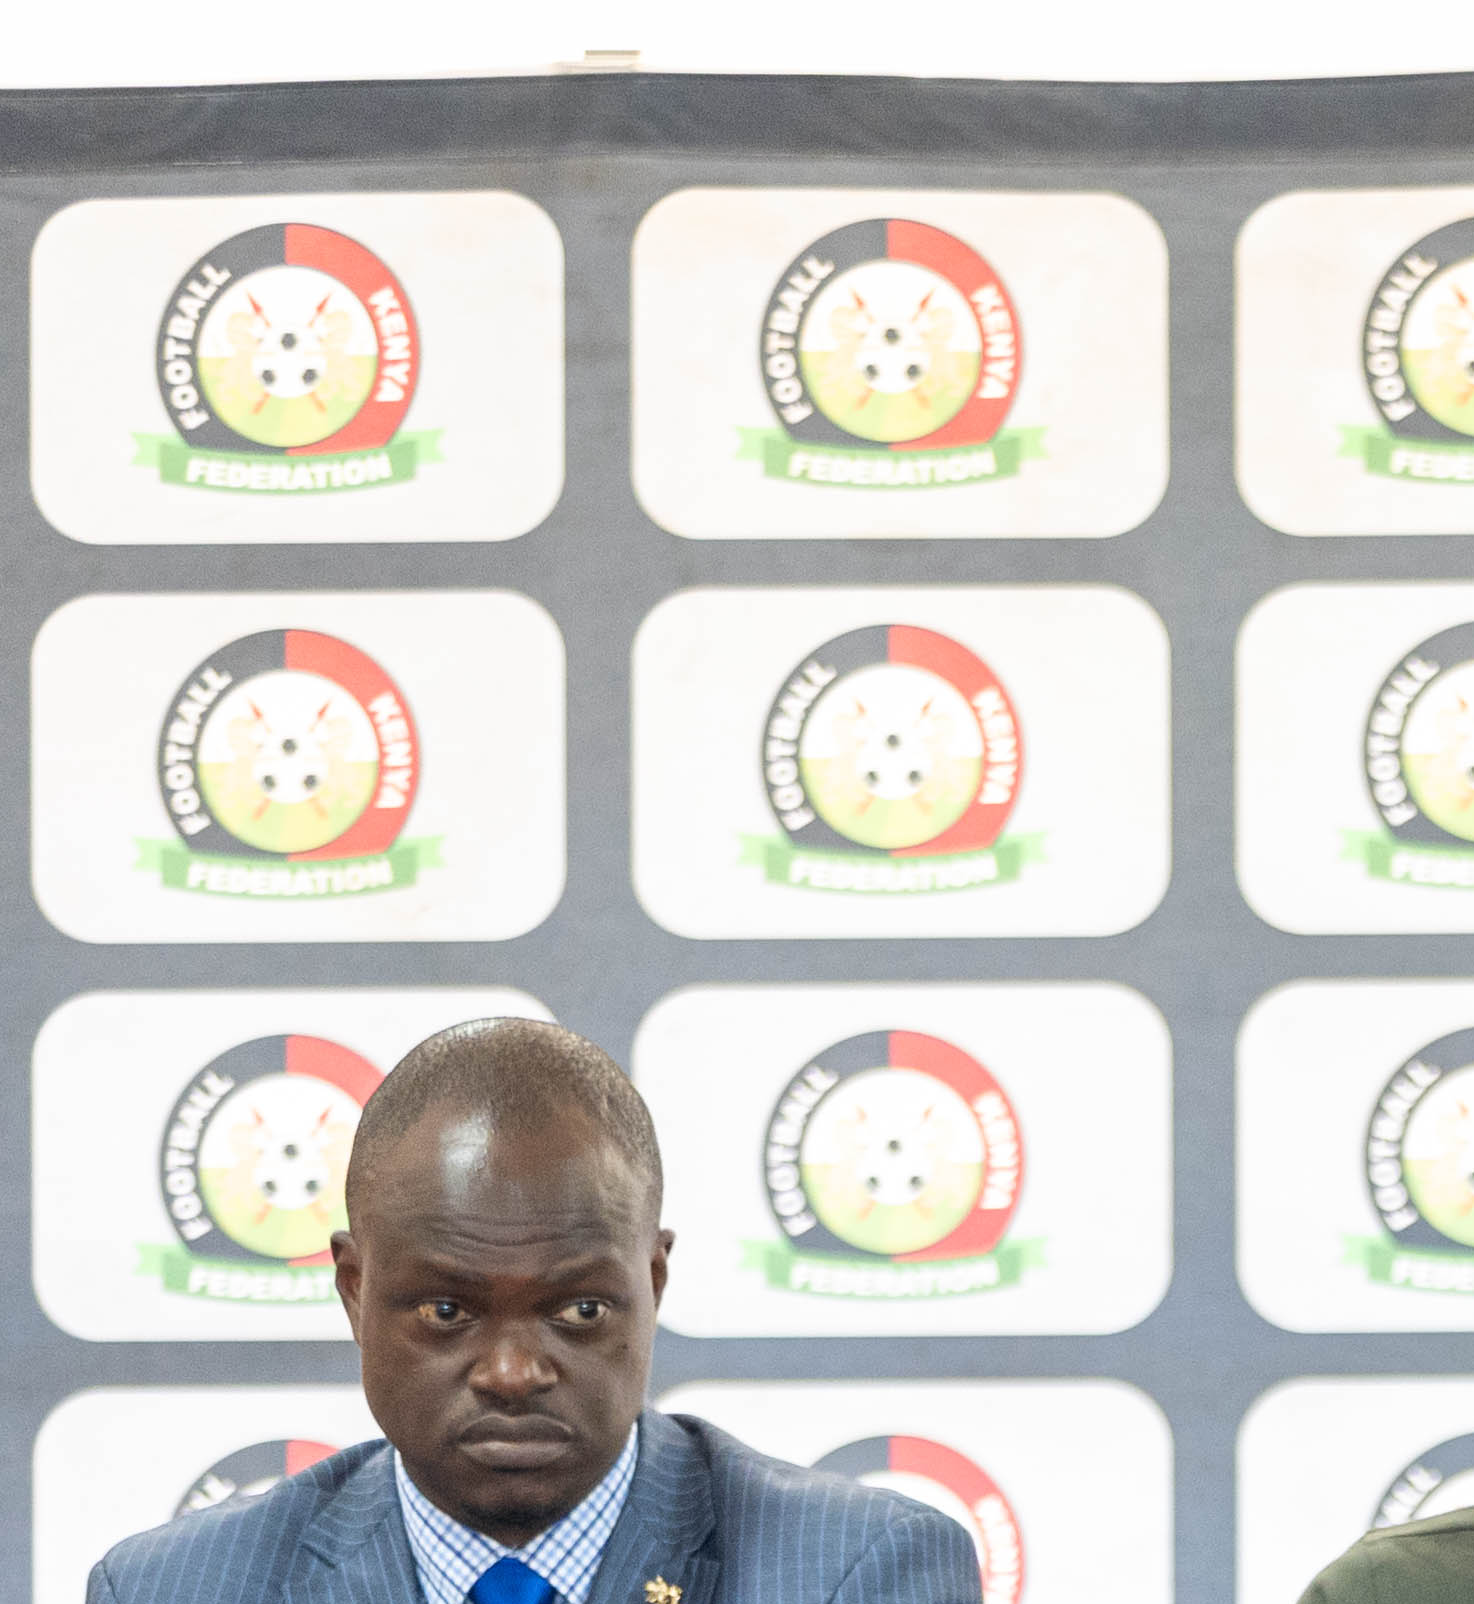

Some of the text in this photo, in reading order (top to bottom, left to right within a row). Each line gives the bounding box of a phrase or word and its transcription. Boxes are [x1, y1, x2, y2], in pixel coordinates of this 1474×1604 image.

[163, 260, 233, 431] FOOTBALL
[766, 254, 836, 425] FOOTBALL
[164, 665, 234, 836] FOOTBALL
[767, 660, 837, 831] FOOTBALL
[190, 1264, 334, 1300] FEDERAT
